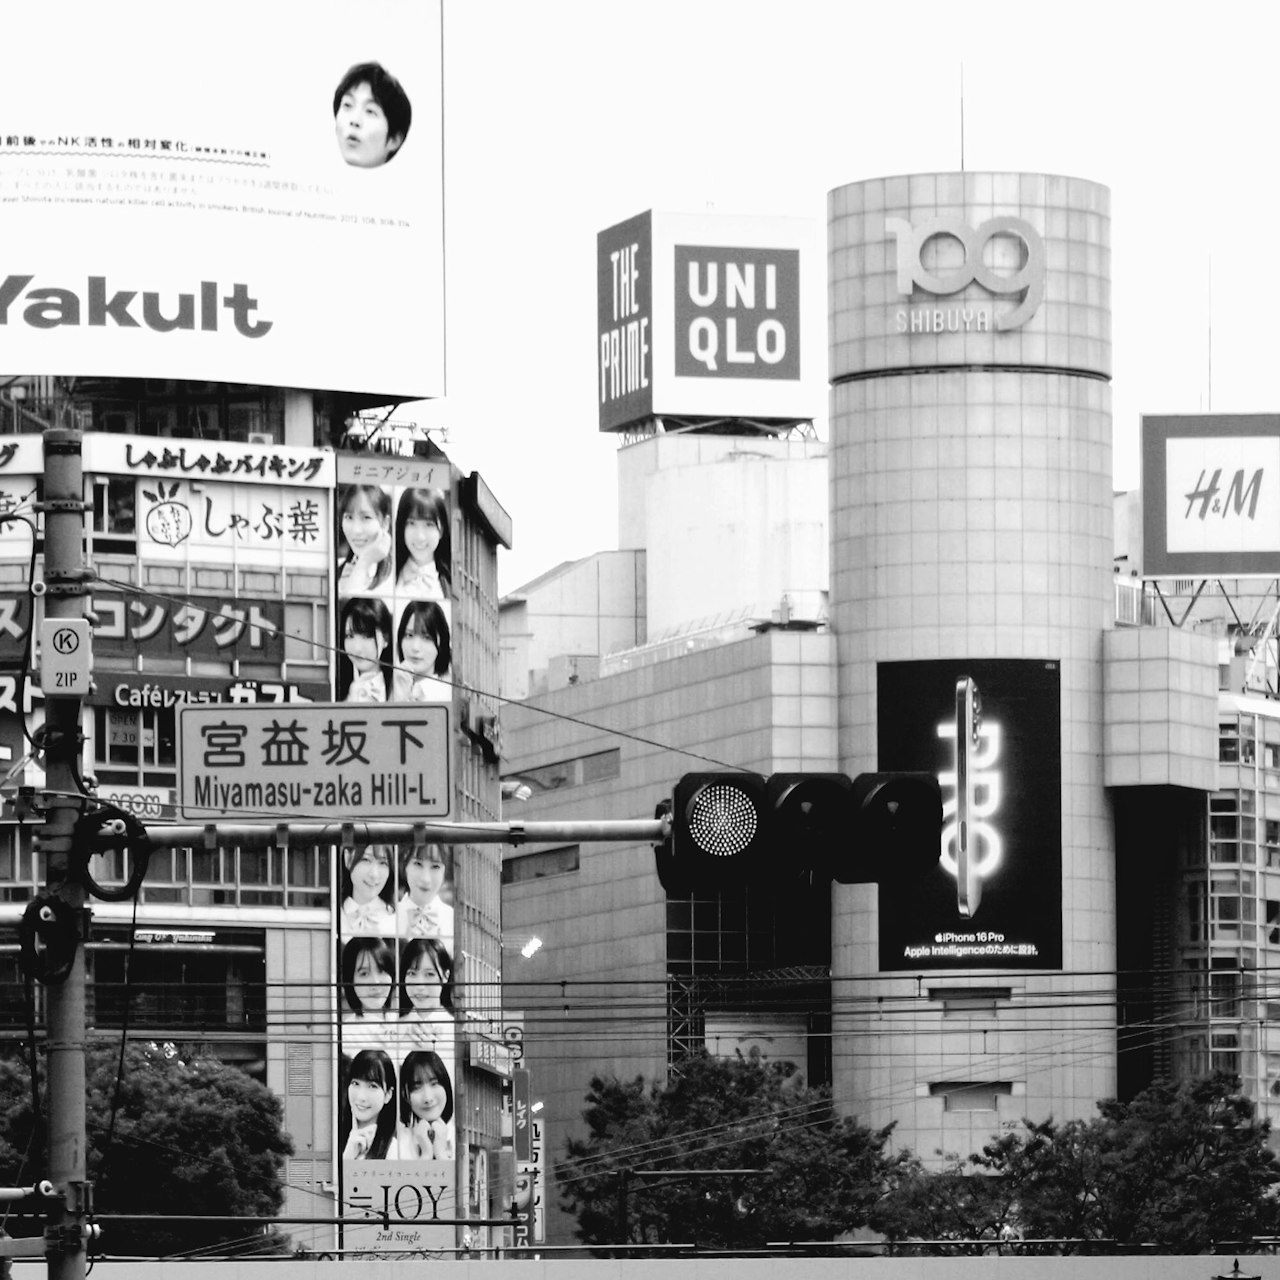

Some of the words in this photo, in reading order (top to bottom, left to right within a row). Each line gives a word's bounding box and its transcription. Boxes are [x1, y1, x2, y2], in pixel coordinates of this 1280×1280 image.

[610, 242, 640, 322] THE
[687, 262, 777, 308] UNI
[885, 215, 1047, 332] 109
[688, 317, 787, 370] QLO
[896, 309, 991, 333] SHIBUYA
[601, 315, 649, 404] PRIME
[126, 444, 324, 481] しゃぶしゃぶバイキング
[1185, 467, 1264, 522] H&M
[205, 497, 320, 544] しゃぶ葉
[201, 719, 428, 767] 宮益坂下
[195, 774, 362, 813] Miyamasu-zaka
[372, 773, 436, 806] Hill-L.
[904, 946, 930, 958] Apple
[943, 932, 974, 944] iPhone
[976, 932, 987, 943] 16
[988, 932, 1005, 944] Pro
[376, 1232, 393, 1241] 2nd
[395, 1231, 421, 1243] Single
